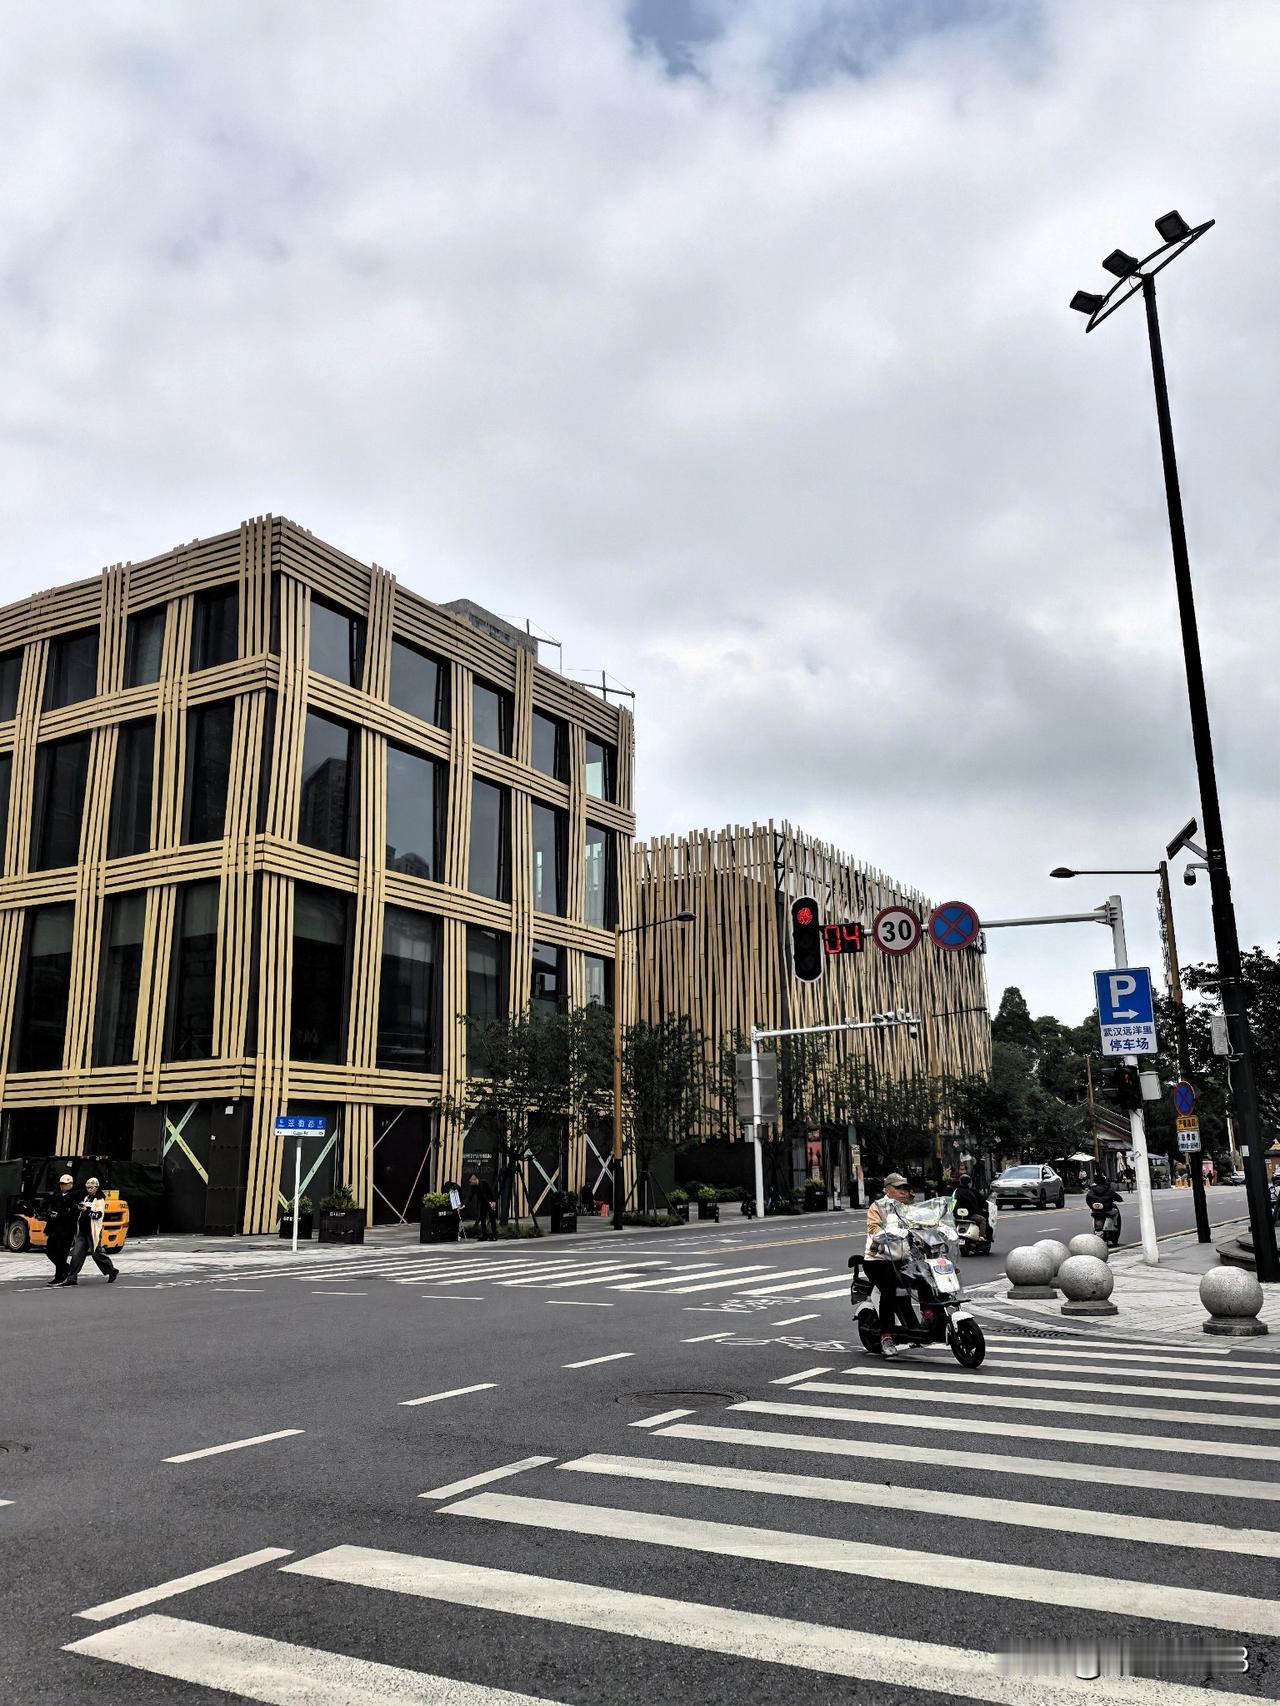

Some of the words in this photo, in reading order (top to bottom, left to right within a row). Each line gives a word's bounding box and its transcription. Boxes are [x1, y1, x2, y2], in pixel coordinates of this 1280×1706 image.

[824, 925, 860, 954] 04
[882, 919, 912, 942] 30
[1109, 975, 1136, 1008] P
[1103, 1025, 1153, 1037] 武汉远洋里
[1110, 1038, 1149, 1052] 停车场
